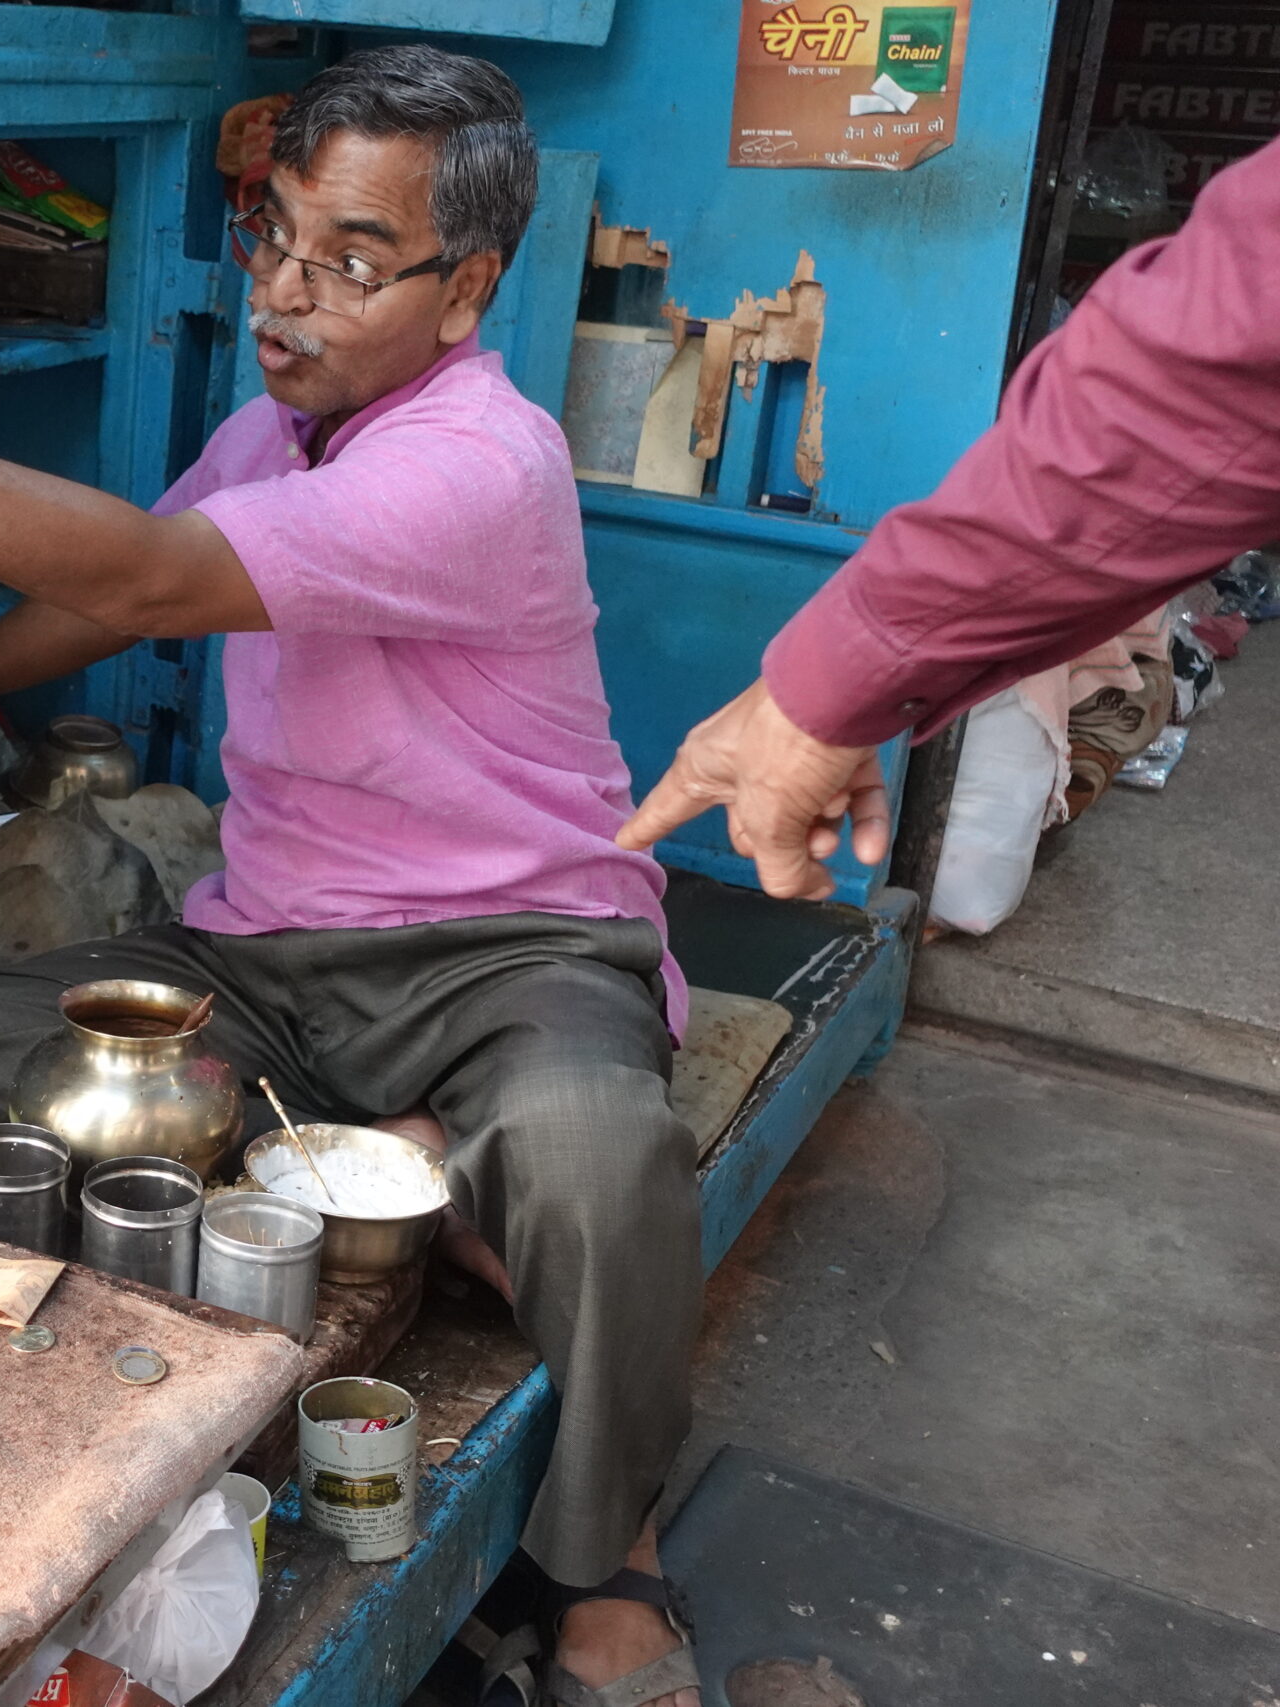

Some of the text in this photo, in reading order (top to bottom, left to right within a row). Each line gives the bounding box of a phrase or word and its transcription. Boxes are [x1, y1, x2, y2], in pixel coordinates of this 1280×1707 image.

[759, 5, 869, 60] चैनी
[887, 44, 943, 60] Chaini
[1113, 83, 1280, 123] FABTE
[927, 116, 944, 132] लो
[757, 129, 773, 137] FREE
[774, 129, 793, 137] INDIA
